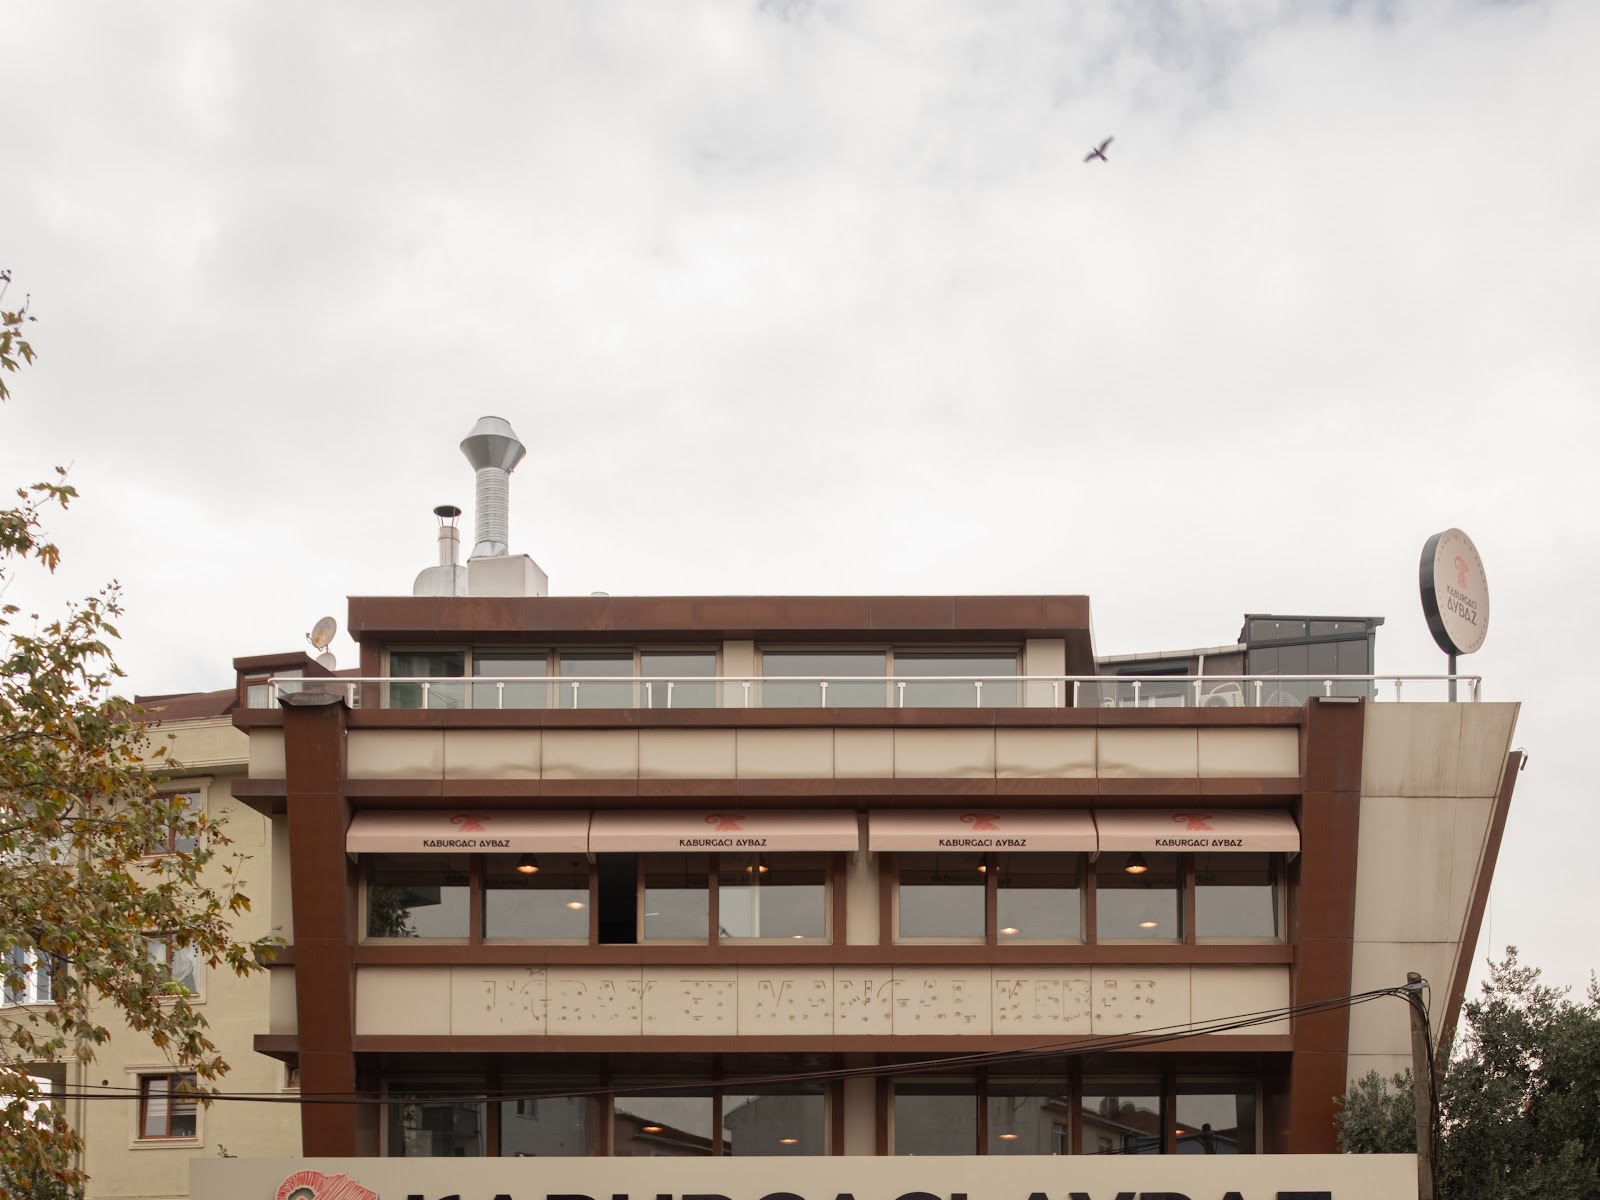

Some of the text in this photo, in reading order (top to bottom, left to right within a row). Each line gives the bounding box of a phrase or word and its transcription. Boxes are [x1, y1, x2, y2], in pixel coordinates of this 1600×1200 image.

[1447, 597, 1477, 626] AYBAZ
[423, 839, 511, 848] KABURGACI AYBAZ
[679, 838, 767, 847] KABURGACI AYBAZ
[938, 838, 1027, 847] KABURGACI AYBAZ
[1155, 838, 1243, 847] KABURGACI AYBAZ
